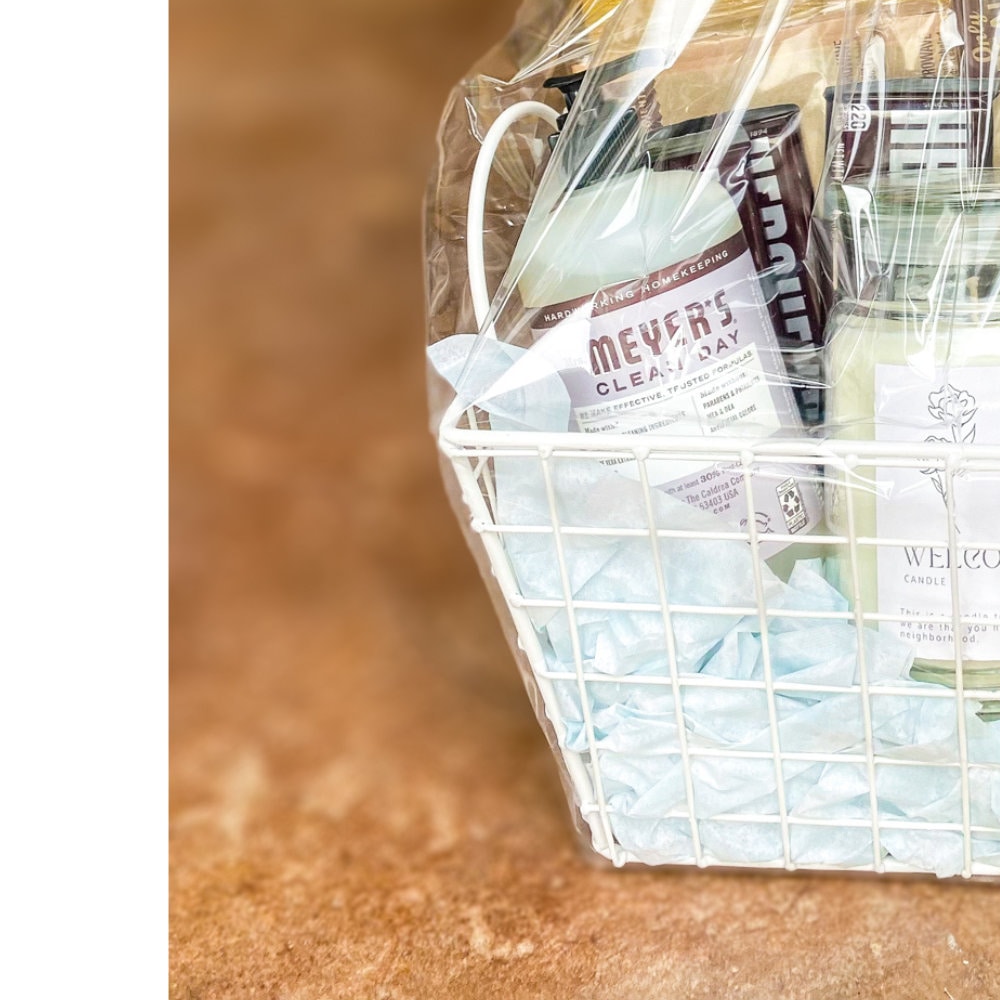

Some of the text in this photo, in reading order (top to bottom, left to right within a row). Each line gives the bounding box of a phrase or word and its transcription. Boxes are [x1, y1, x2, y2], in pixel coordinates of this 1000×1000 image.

[543, 290, 635, 323] HARDRKING
[903, 574, 946, 586] CANDLE
[939, 622, 955, 632] tha
